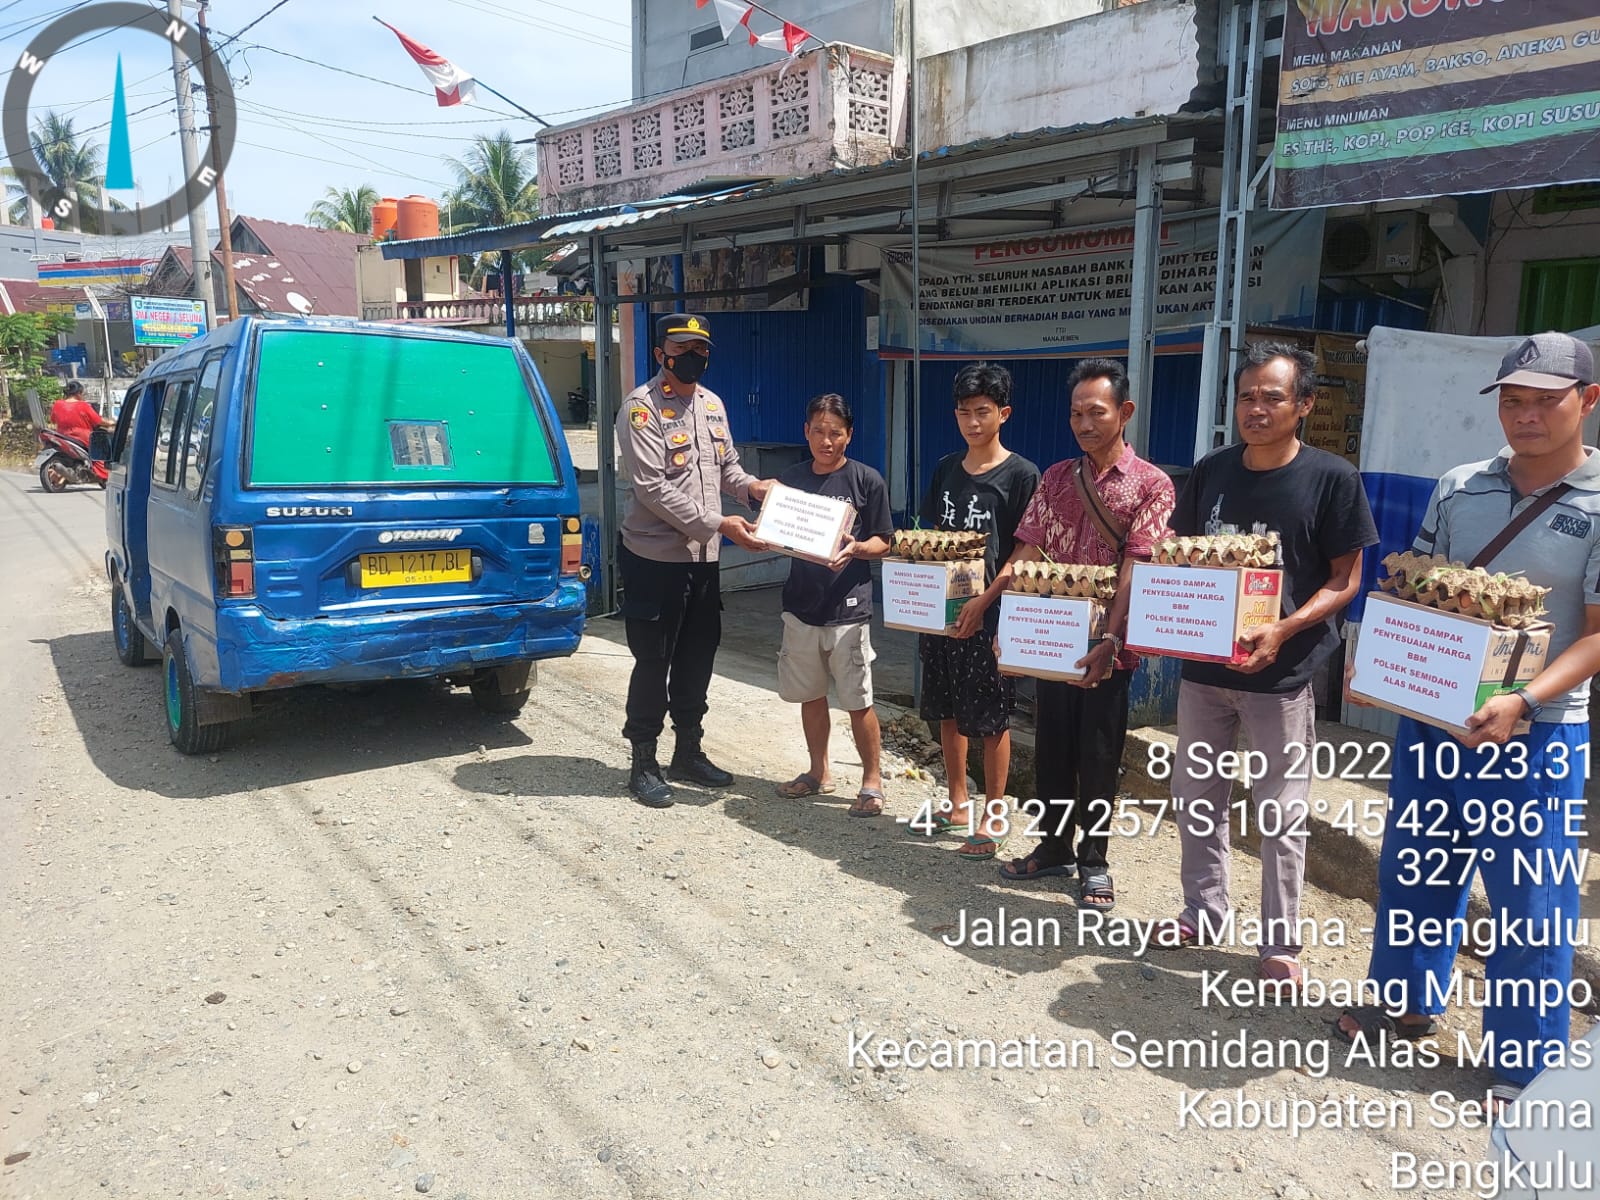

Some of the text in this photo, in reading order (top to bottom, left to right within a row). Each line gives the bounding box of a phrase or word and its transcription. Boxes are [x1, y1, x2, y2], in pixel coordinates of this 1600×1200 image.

[1331, 40, 1402, 63] MAKANAN
[1337, 72, 1365, 89] MIE
[1369, 62, 1421, 83] AYAM,
[1425, 49, 1493, 72] BAKSO,
[1496, 36, 1567, 61] ANEKA
[1283, 102, 1600, 157] ES THE, KOPI, POP ICE, KOPI SUSU
[1286, 106, 1390, 131] MENU MINUMAN
[919, 276, 950, 287] EPADA
[952, 274, 976, 285] YTH.
[978, 270, 1028, 283] SELURUH
[1031, 263, 1087, 278] NASABAH
[1090, 260, 1126, 273] BANK
[911, 299, 974, 311] ENDATANGI
[977, 298, 995, 308] BRI
[998, 293, 1057, 307] TERDEKAT
[1060, 290, 1102, 303] UNTUK
[1105, 283, 1188, 300] MELKAN
[919, 288, 938, 298] ANG
[941, 286, 979, 298] BELUM
[983, 281, 1037, 295] MEMILIKI
[1041, 275, 1101, 291] APLIKASI
[969, 315, 1001, 325] UNDIAN
[1004, 311, 1058, 324] BERHADIAH
[1061, 310, 1085, 320] BAGI
[1087, 308, 1116, 318] YANG
[266, 506, 353, 517] SUZUKI
[400, 553, 437, 574] 1217
[1151, 577, 1217, 589] BANSOS DAMPAK
[1142, 588, 1225, 602] PENYESUAIAN HARGA
[1172, 603, 1189, 611] BBM
[1145, 613, 1218, 628] POLSEK SEMIDANG
[1155, 626, 1204, 638] ALAS MARAS
[1384, 616, 1463, 644] BANSOS DAMPAK
[1373, 627, 1472, 661] PENYESUAIAN HARGA
[1407, 651, 1428, 664] BBM
[1373, 657, 1458, 690] POLSEK SEMIDANG
[1383, 675, 1440, 700] ALAS MARAS
